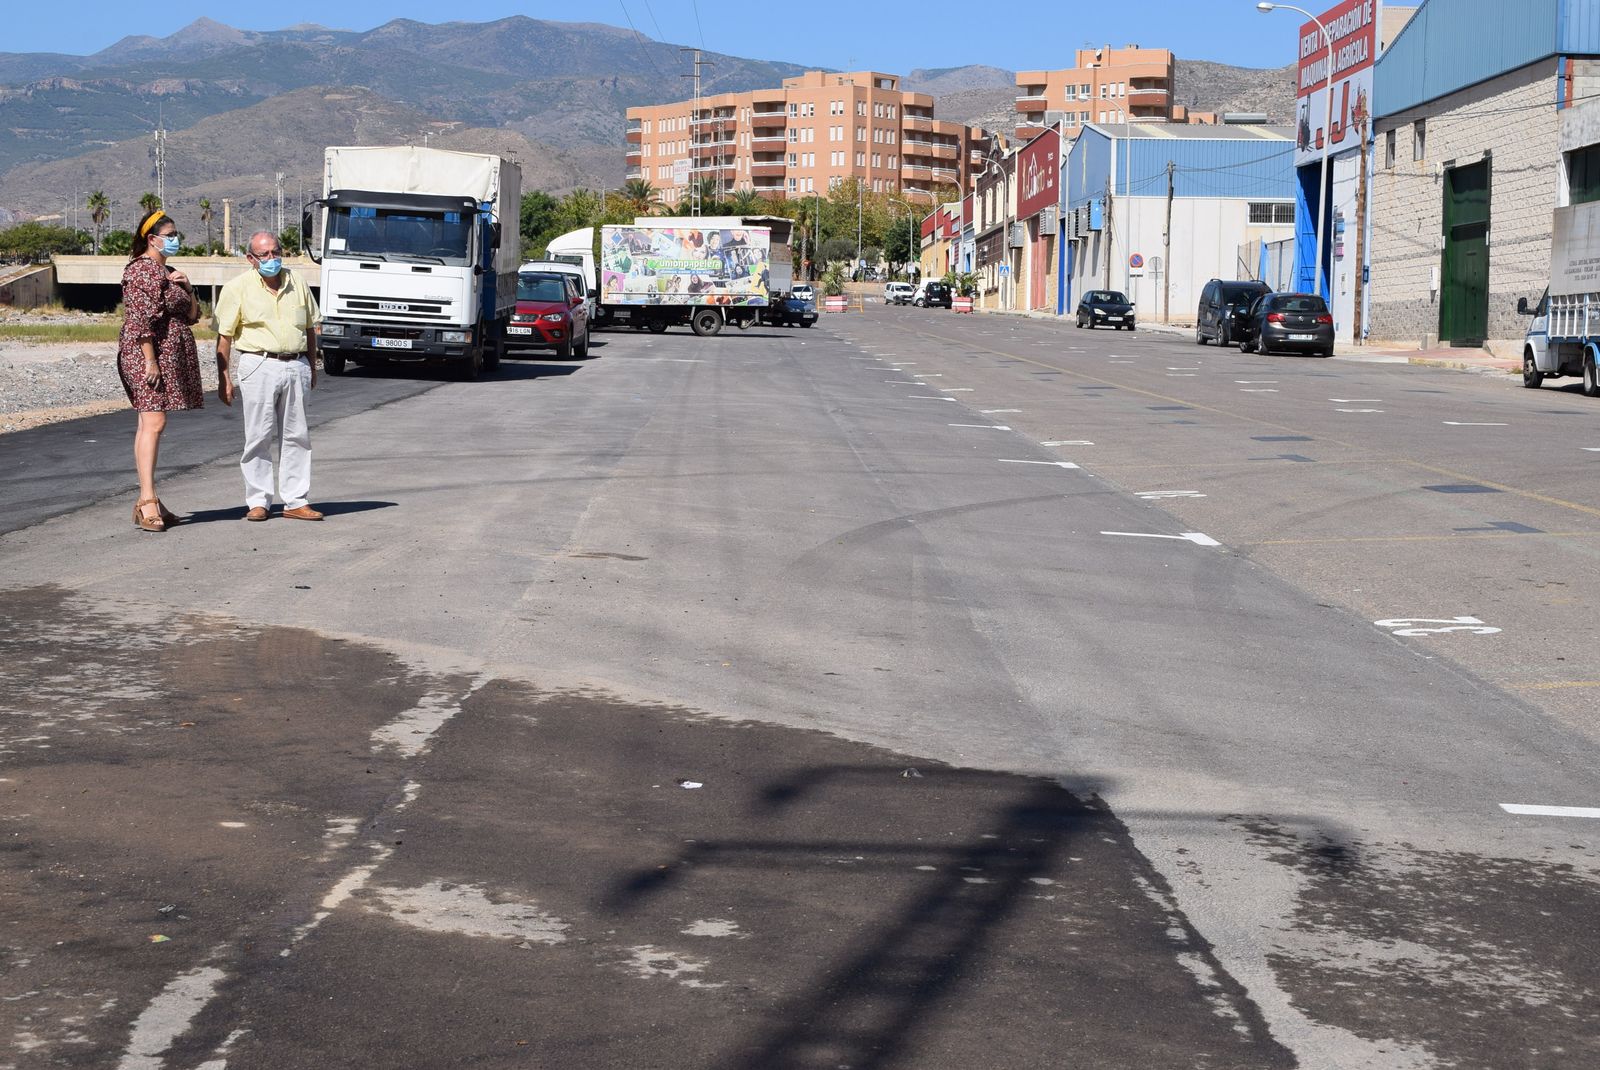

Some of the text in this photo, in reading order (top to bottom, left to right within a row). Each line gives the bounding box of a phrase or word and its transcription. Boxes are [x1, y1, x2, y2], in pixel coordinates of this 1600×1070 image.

[1301, 30, 1318, 59] VENTA
[1323, 1, 1362, 47] REPARACIÓN
[1363, 0, 1372, 26] DE
[1337, 36, 1368, 73] AGRÍCOLA
[379, 302, 410, 312] IVECO
